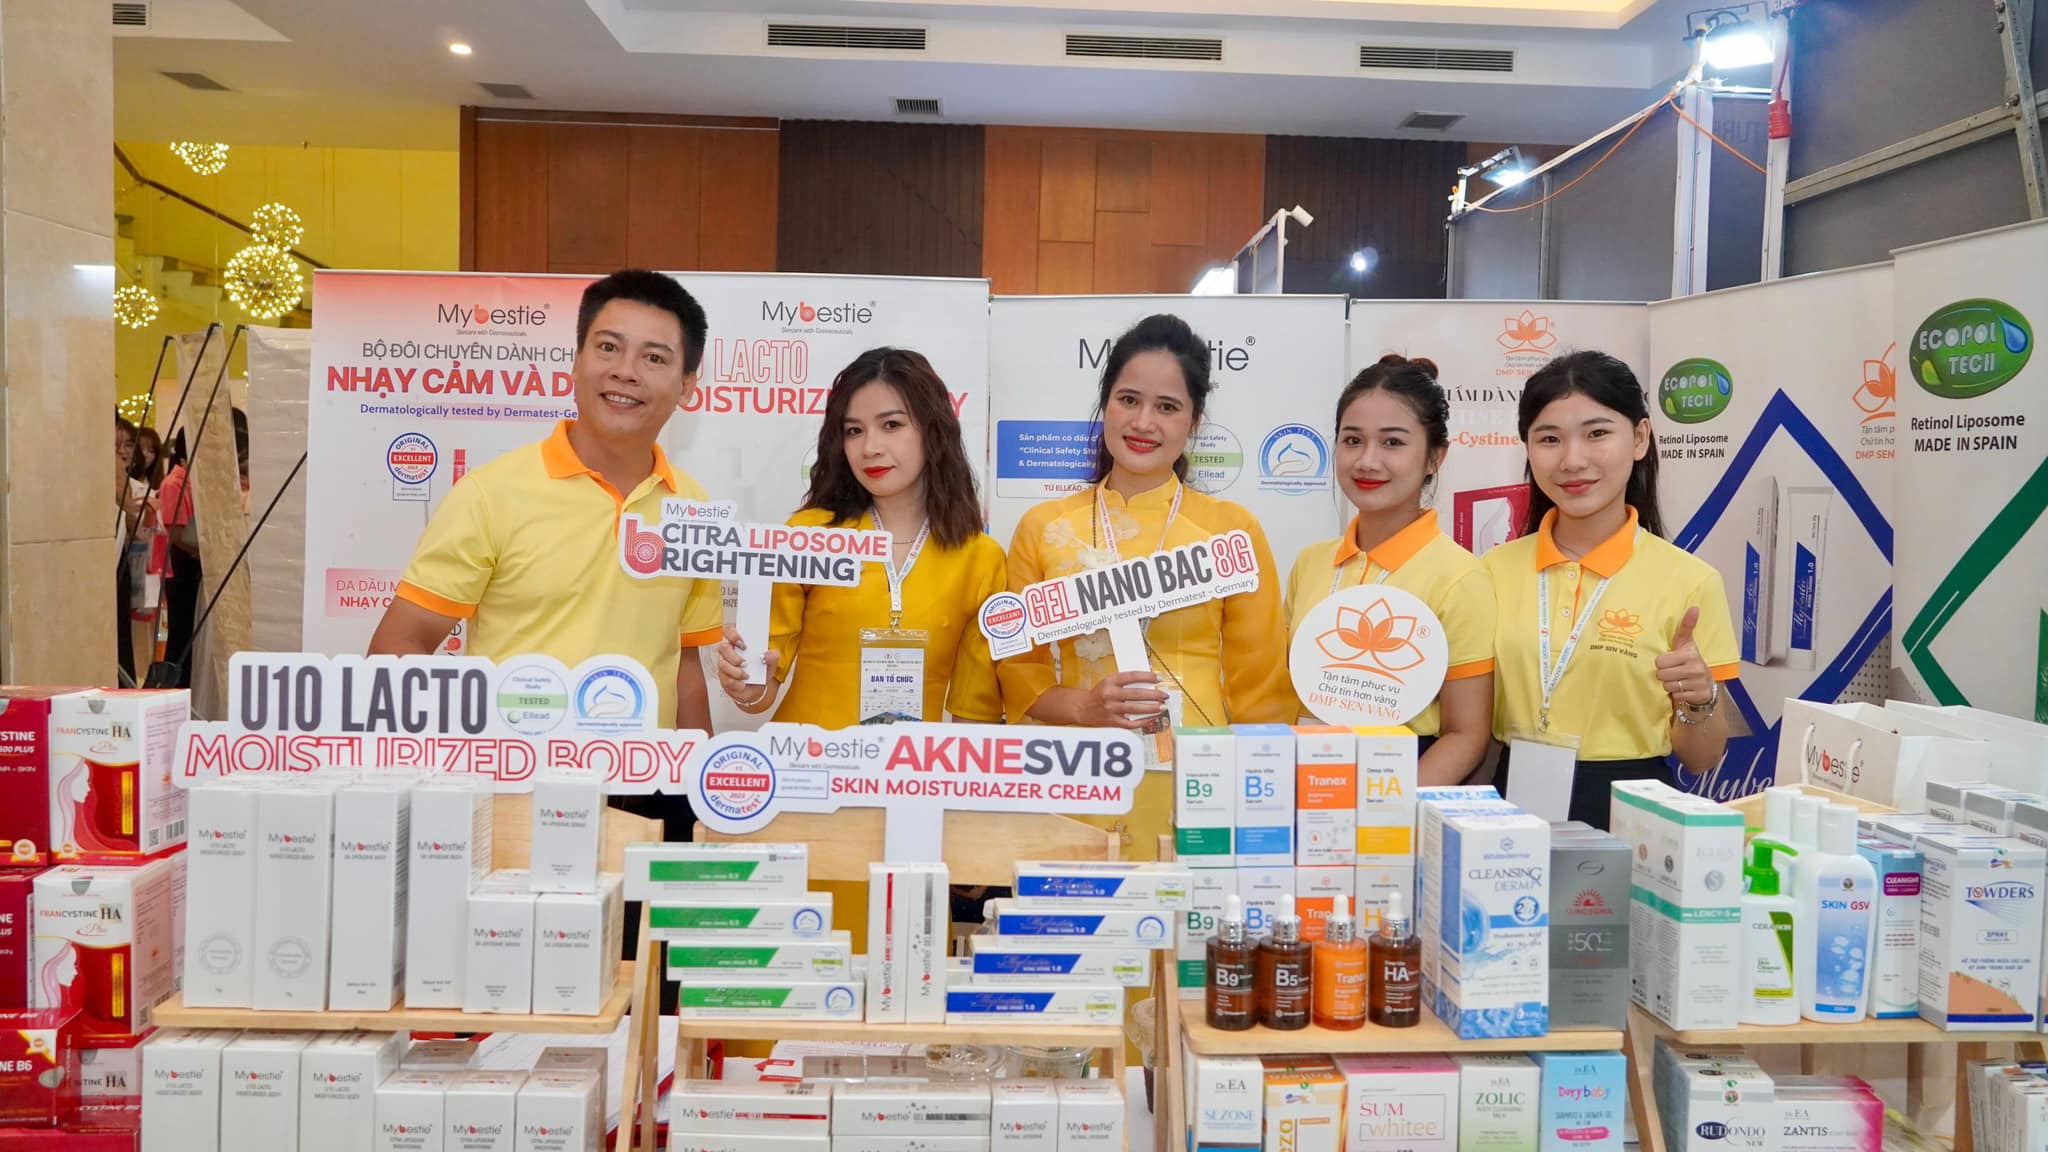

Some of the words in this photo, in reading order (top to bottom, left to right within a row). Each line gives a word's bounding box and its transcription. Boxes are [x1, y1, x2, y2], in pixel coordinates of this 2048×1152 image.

[762, 300, 873, 326] Mybestie
[1919, 320, 1996, 351] ECOPOL
[362, 339, 387, 361] BỘ
[390, 340, 420, 360] ĐÔI
[423, 339, 492, 361] CHUYÊN
[497, 341, 546, 361] DÀNH
[550, 346, 575, 362] CH
[714, 338, 808, 384] LACTO
[327, 366, 416, 398] NHẠY
[422, 360, 493, 396] CẢM
[500, 363, 546, 397] VÀ
[1664, 372, 1713, 391] ECOPOL
[360, 404, 449, 418] Dermatologically
[451, 405, 484, 417] tested
[487, 406, 500, 419] by
[504, 405, 578, 420] Dermatest-Ge
[1911, 414, 1954, 432] Retinol
[1957, 412, 2026, 430] Liposome
[395, 437, 430, 450] ORIGINAL
[1450, 431, 1520, 448] -Cystine
[1659, 433, 1684, 445] Retinol
[1686, 433, 1728, 446] Liposome
[1915, 437, 1950, 452] MADE
[1957, 436, 1969, 450] IN
[1973, 435, 2018, 450] SPAIN
[393, 454, 431, 463] EXCELLENT
[1055, 447, 1081, 456] Safety
[1194, 455, 1225, 464] TESTED
[1661, 449, 1683, 459] MADE
[1687, 448, 1696, 459] IN
[1699, 447, 1725, 458] SPAIN
[1856, 449, 1874, 459] DMP
[1018, 459, 1025, 467] &
[1198, 470, 1225, 479] Ellead
[666, 503, 729, 519] Mybestie
[662, 523, 741, 548] CITRA
[749, 529, 887, 557] LIPOSOME
[1025, 580, 1079, 628] GEL
[1075, 560, 1153, 615] NANO
[1157, 545, 1213, 594] BAC
[1211, 533, 1255, 578] 8G
[340, 596, 379, 610] NHẠY
[1037, 614, 1113, 642] Dermatologically
[1115, 606, 1143, 621] tested
[1144, 603, 1157, 618] by
[1158, 590, 1207, 610] Dermatest
[1215, 578, 1255, 597] Germany
[988, 611, 1020, 623] EXCELLENT
[1605, 645, 1618, 653] SEN
[242, 664, 321, 731] U10
[341, 665, 488, 734] LACTO
[519, 697, 550, 705] TESTED
[1309, 692, 1337, 706] DMP
[1339, 698, 1363, 713] SEN
[112, 724, 132, 739] HA
[771, 736, 880, 763] Mybestie
[548, 740, 695, 784] BODY
[713, 751, 763, 769] ORIGINAL
[709, 776, 767, 788] EXCELLENT
[1186, 779, 1213, 798] B9
[1245, 775, 1275, 798] B5
[1307, 774, 1347, 787] Tranex
[1366, 774, 1403, 797] HA
[831, 776, 880, 796] SKIN
[886, 778, 1042, 799] MOISTURIAZER
[1049, 783, 1122, 802] CREAM
[710, 794, 762, 814] dermatest
[1469, 867, 1543, 887] CLEANSING
[1821, 899, 1847, 909] SKIN
[1850, 900, 1870, 911] GSV
[101, 907, 122, 921] HA
[1216, 968, 1240, 987] B9
[1275, 968, 1299, 987] B5
[1384, 966, 1410, 982] HA
[17, 1060, 32, 1071] B6
[106, 1076, 126, 1088] HA
[1475, 1092, 1526, 1105] ZOLIC
[1359, 1102, 1404, 1117] SUM
[1700, 1124, 1766, 1137] RUDONDO
[1784, 1127, 1828, 1137] ZANTIS
